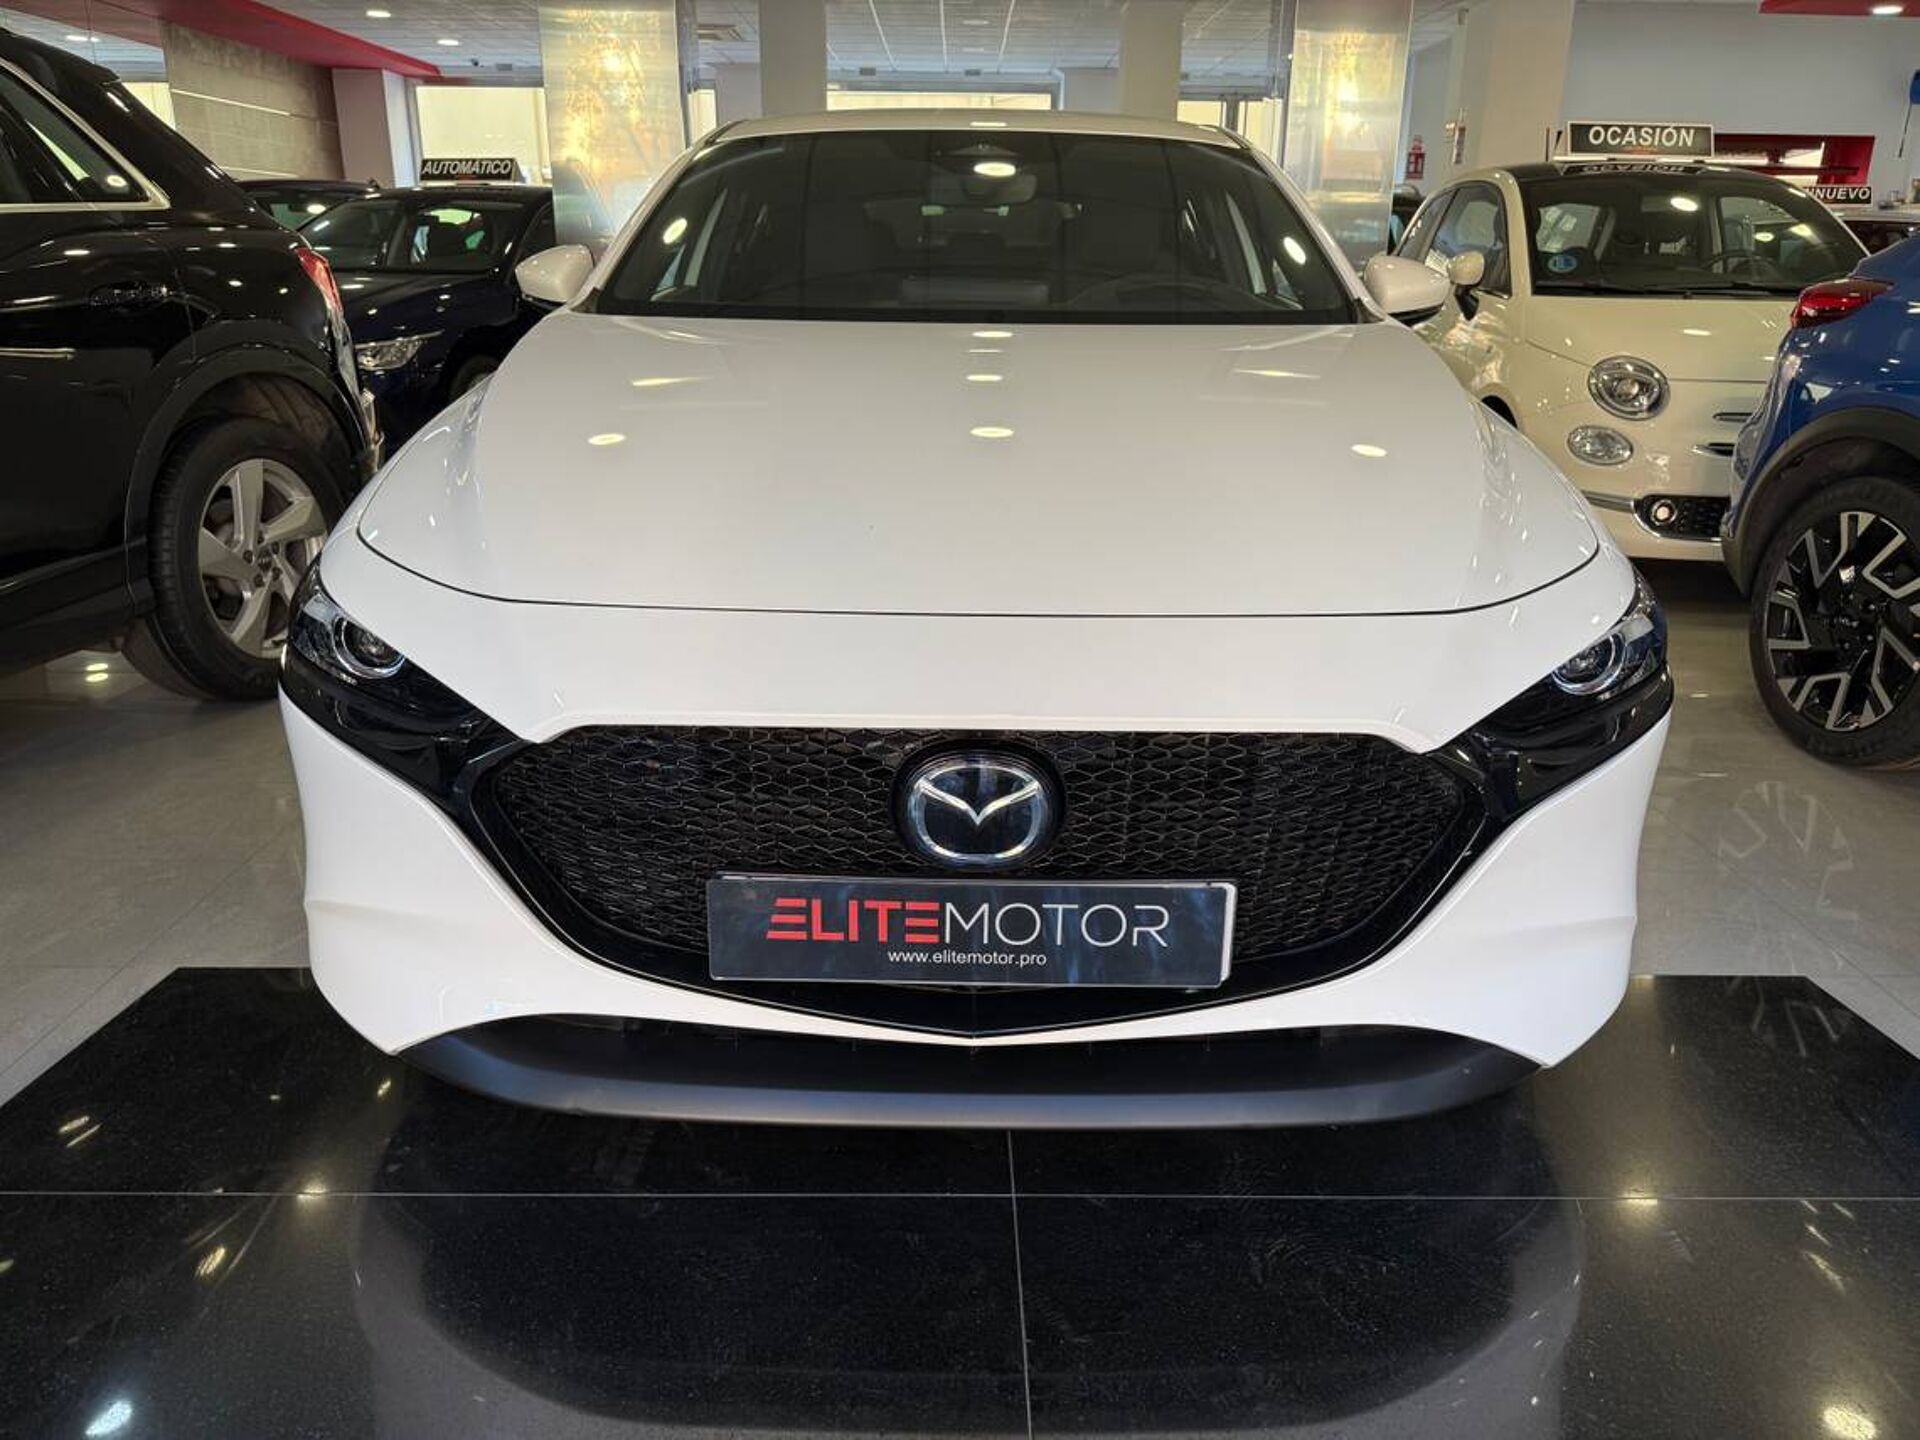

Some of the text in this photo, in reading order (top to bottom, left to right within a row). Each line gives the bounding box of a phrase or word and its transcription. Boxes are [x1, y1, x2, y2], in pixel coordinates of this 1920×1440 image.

[1589, 125, 1695, 147] OCASIÓN
[766, 898, 1169, 947] ELITEMOTOR
[888, 950, 1047, 968] www.elitemotor.pro
